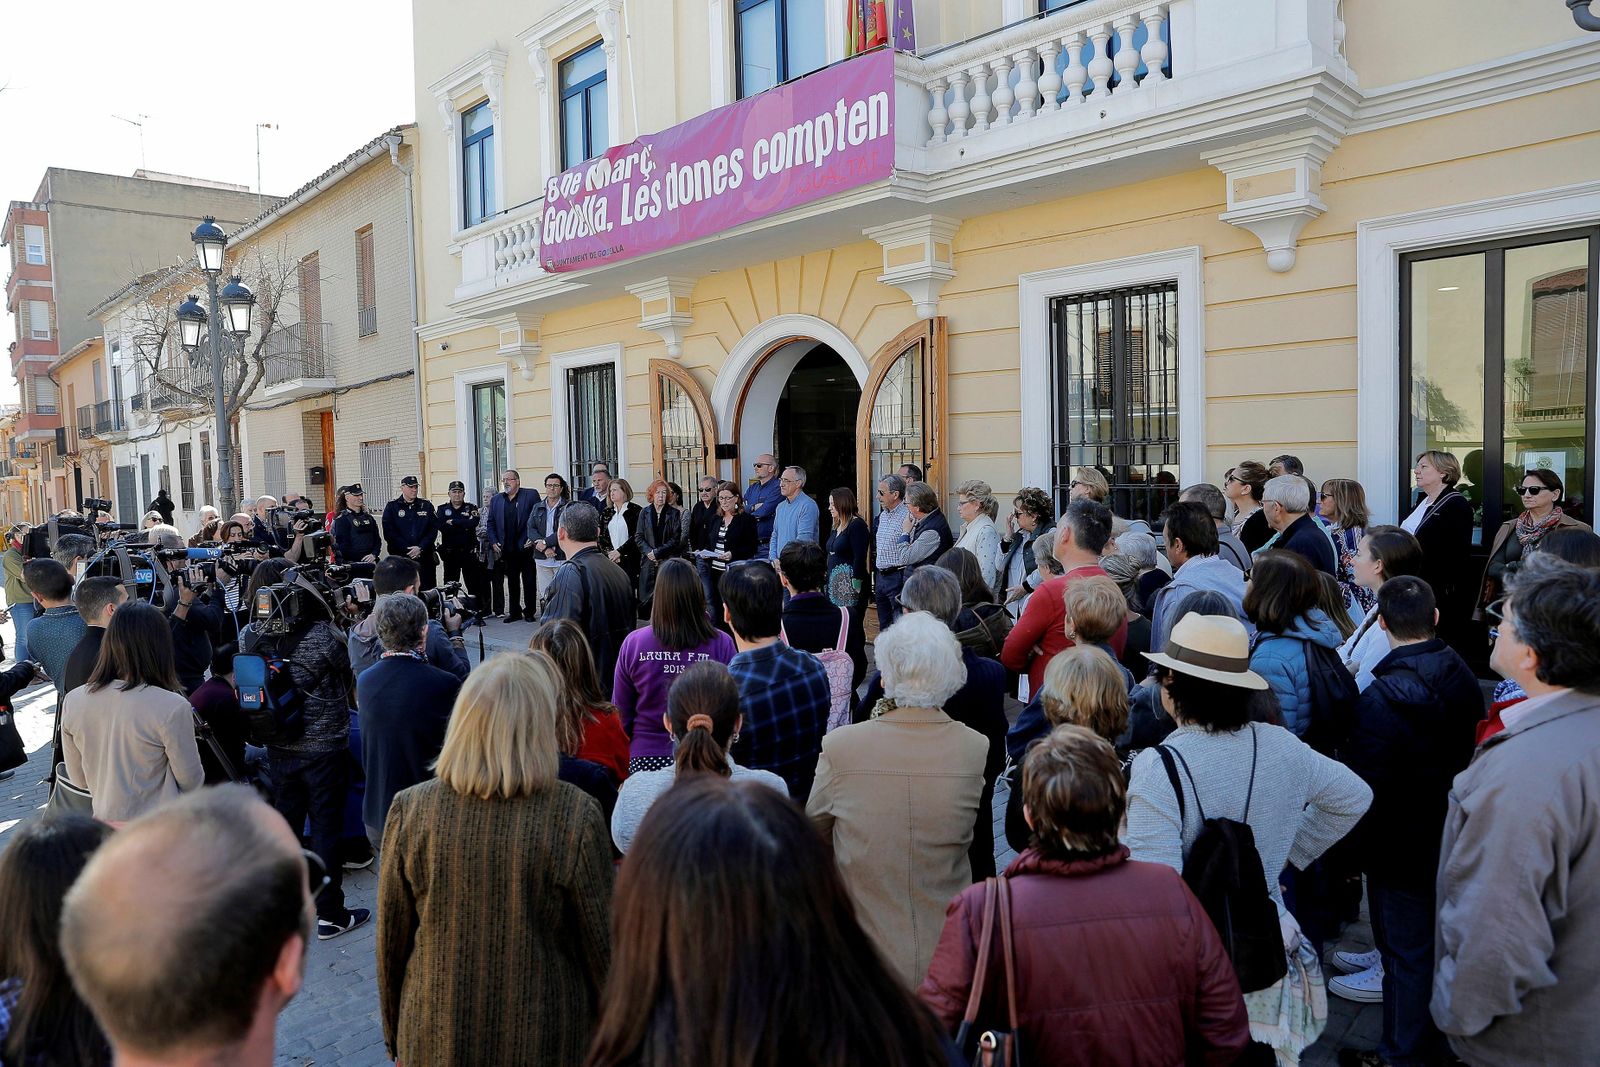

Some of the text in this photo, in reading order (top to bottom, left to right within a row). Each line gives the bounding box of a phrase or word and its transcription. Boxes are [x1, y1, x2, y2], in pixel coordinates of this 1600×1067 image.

[621, 179, 663, 226] Les
[665, 148, 744, 211] dones
[752, 91, 889, 181] compten
[547, 177, 560, 203] 8
[589, 251, 597, 259] DE
[135, 571, 152, 581] tve
[638, 651, 681, 662] LAURA
[663, 664, 686, 674] 2013
